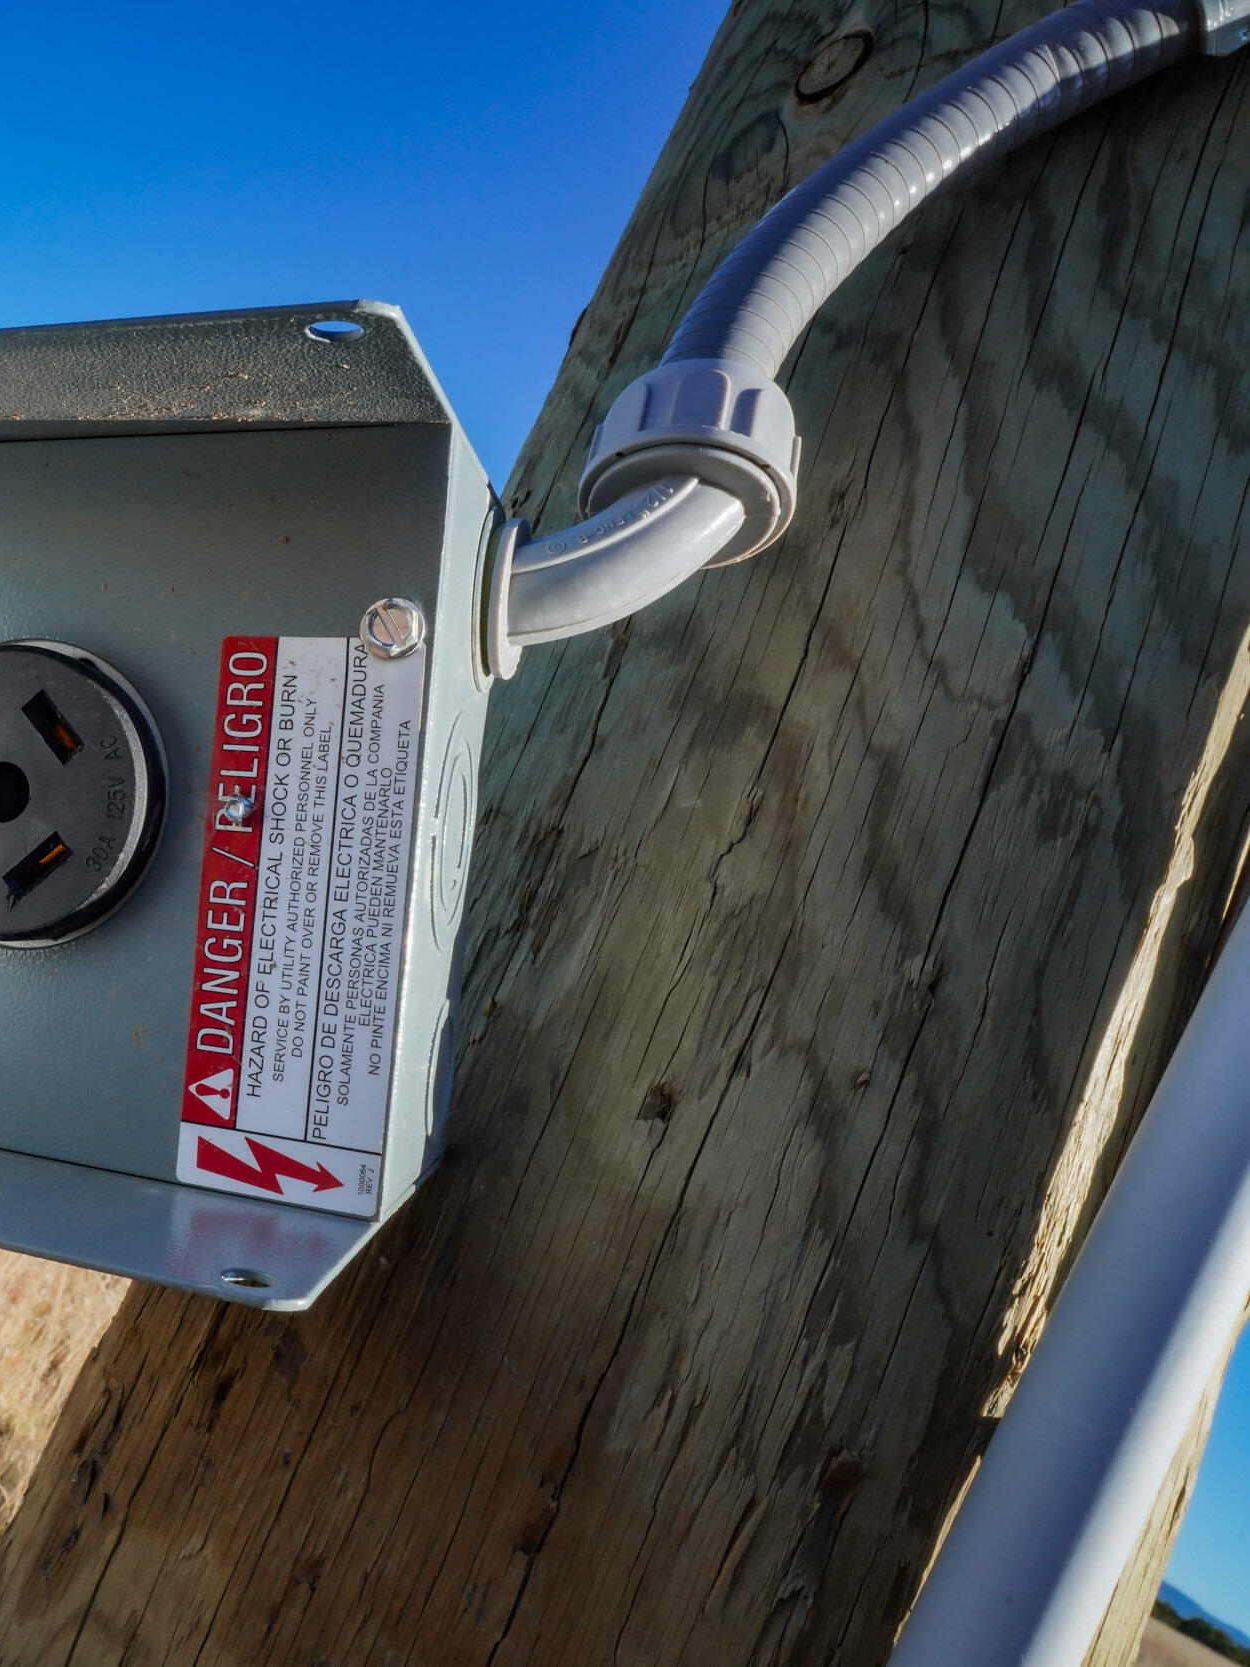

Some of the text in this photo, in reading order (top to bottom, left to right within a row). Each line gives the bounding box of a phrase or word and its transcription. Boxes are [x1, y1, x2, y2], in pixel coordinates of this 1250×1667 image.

[86, 735, 125, 872] 30A 125V AC
[197, 652, 267, 1054] DANGER / PELIGRO
[246, 674, 298, 1098] HAZARD OF ELECTRICAL SHOCK OR BURN
[272, 697, 317, 1083] SERVICE BY UTILITY AUTHORIZED PERSONNEL ONLY
[291, 726, 332, 1058] DO NOT PAINT OVER OR REMOVE THIS LABEL
[312, 642, 371, 1140] PELIGRO DE DESCARGA ELECTRICA O QUEMADURA
[336, 684, 385, 1106] SOLAMENTE PERSONAS AUTORIZADAS DE LA COMPANIA
[358, 767, 392, 1027] ELECTRICA PUEDEN MANTENARLO
[368, 720, 411, 1076] NO PINTE ENCIMA NI REMUEVA ESTA ETIQUETA
